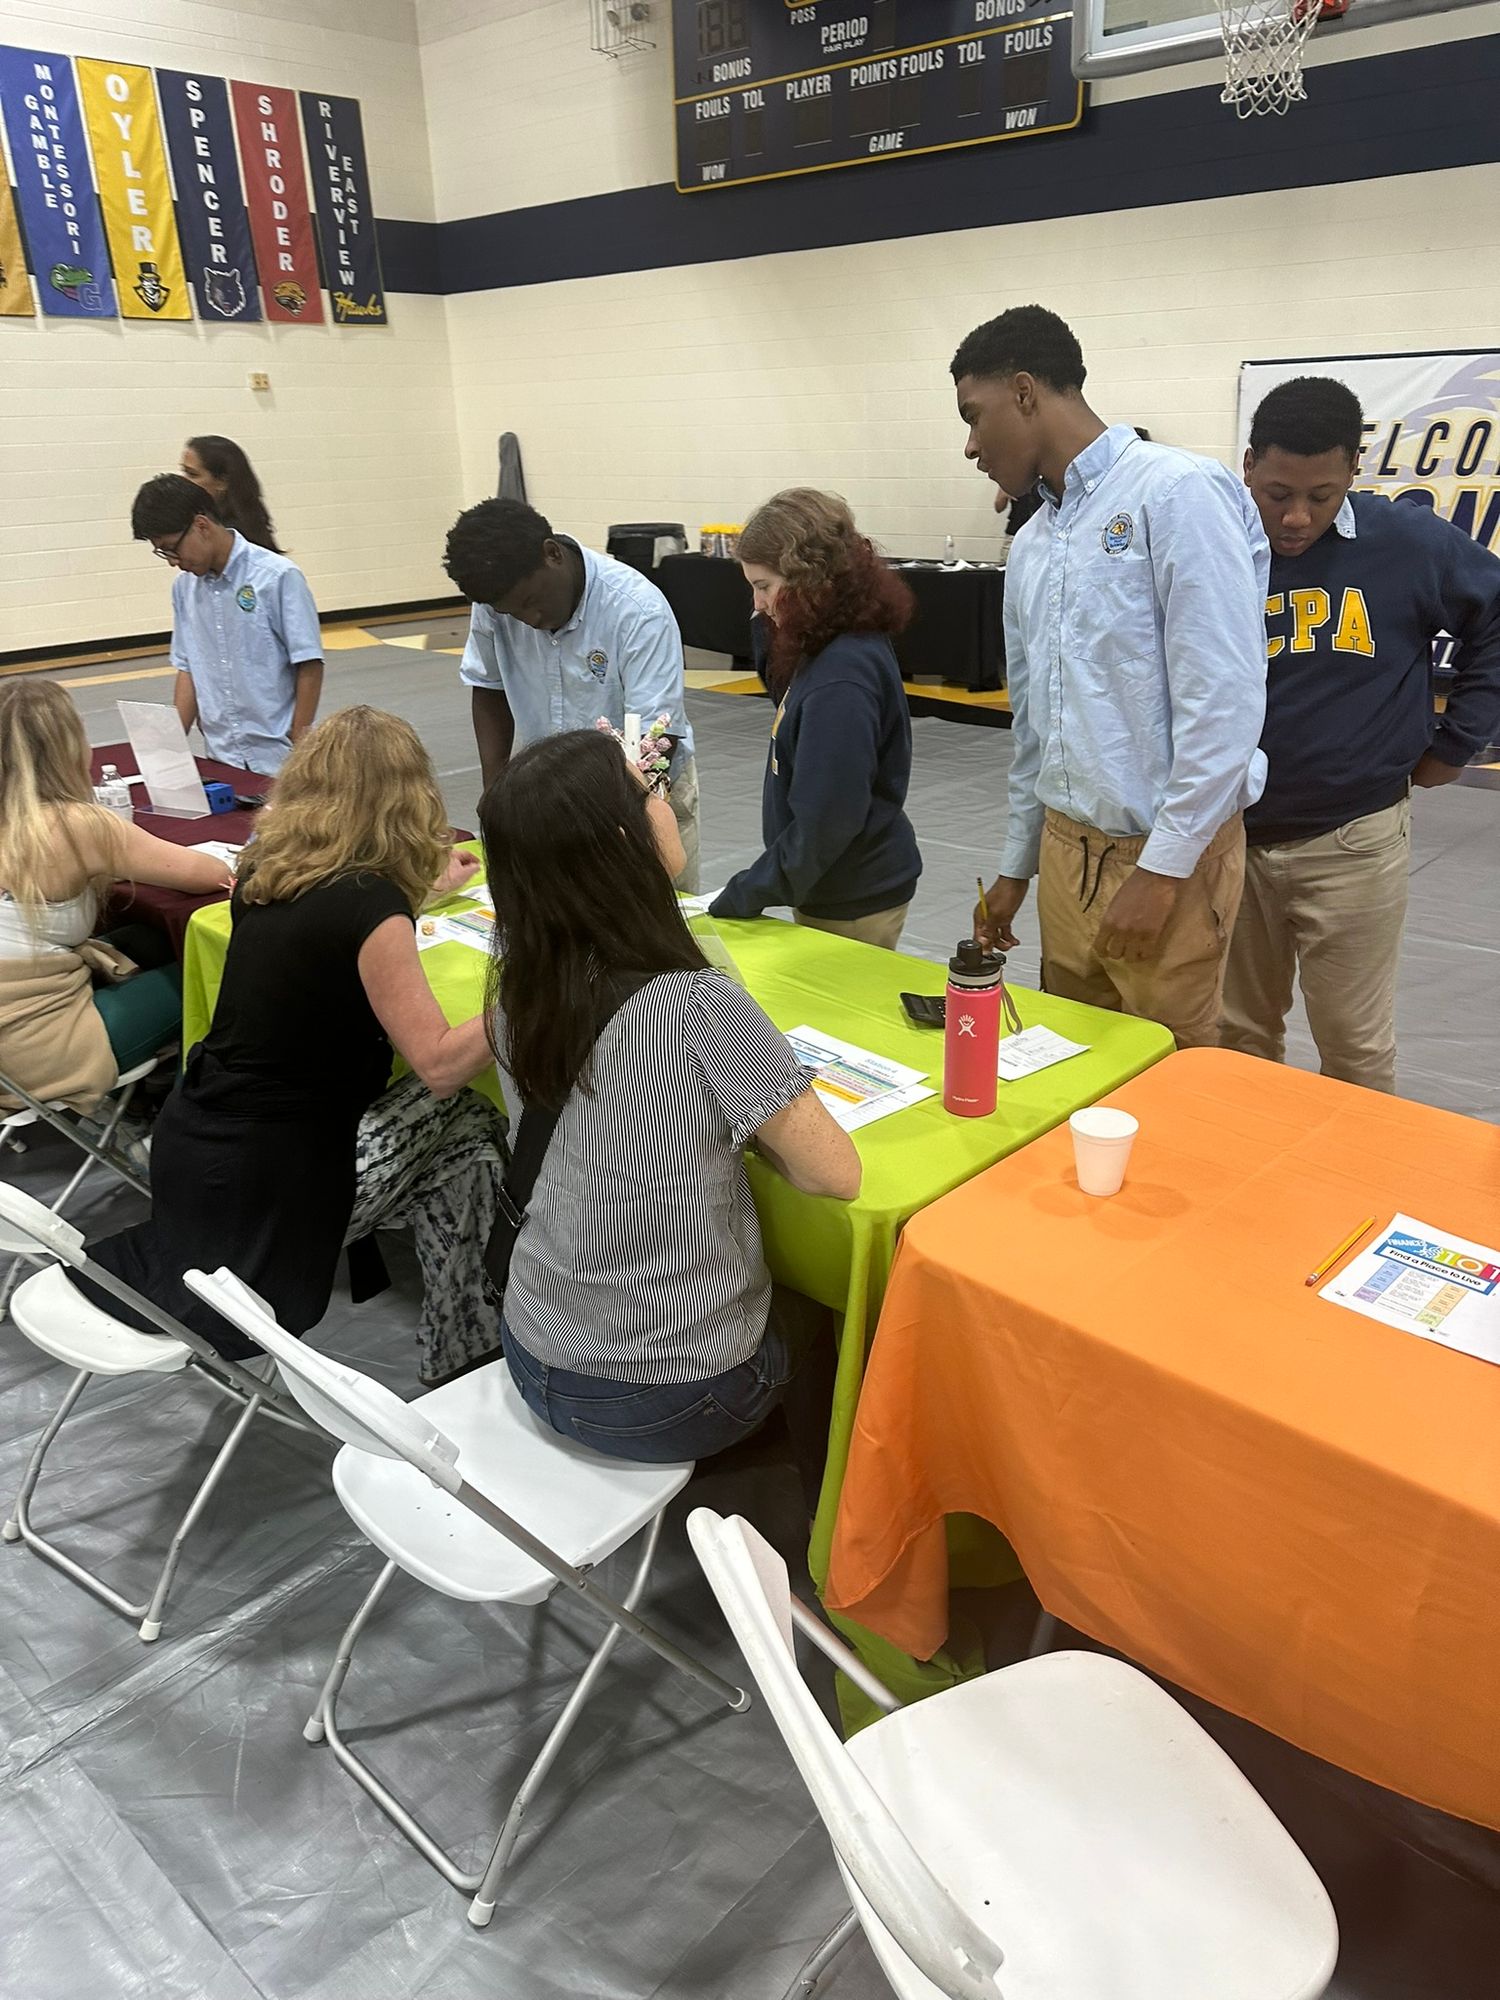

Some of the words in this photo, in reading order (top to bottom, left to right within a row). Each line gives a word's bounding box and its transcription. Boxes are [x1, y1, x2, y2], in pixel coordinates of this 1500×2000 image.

[790, 6, 816, 25] POSS
[821, 16, 868, 45] PERIOD
[823, 43, 842, 54] FAIR
[843, 38, 864, 50] PLAY
[975, 0, 1026, 22] BONUS
[695, 97, 731, 120] FOULS
[742, 89, 765, 110] TOL
[786, 74, 831, 100] PLAYER
[850, 59, 898, 87] POINTS
[900, 49, 944, 76] FOULS
[957, 40, 986, 64] TOL
[1004, 25, 1053, 54] FOULS
[713, 57, 752, 82] BONUS
[24, 94, 57, 209] GAMBLE
[34, 63, 81, 255] MONTESSORI
[105, 74, 154, 252] OYLER
[185, 80, 228, 264] SPENCER
[702, 163, 726, 181] WON
[869, 132, 904, 153] GAME
[1005, 107, 1038, 129] WON
[257, 94, 294, 272] SHRODER
[318, 100, 355, 287] RIVERVIEW
[341, 155, 359, 235] EAST
[1354, 418, 1500, 478] ELCO
[1389, 1249, 1411, 1261] Find
[1420, 1261, 1448, 1274] Place
[1449, 1271, 1460, 1279] to
[1461, 1275, 1481, 1286] Live
